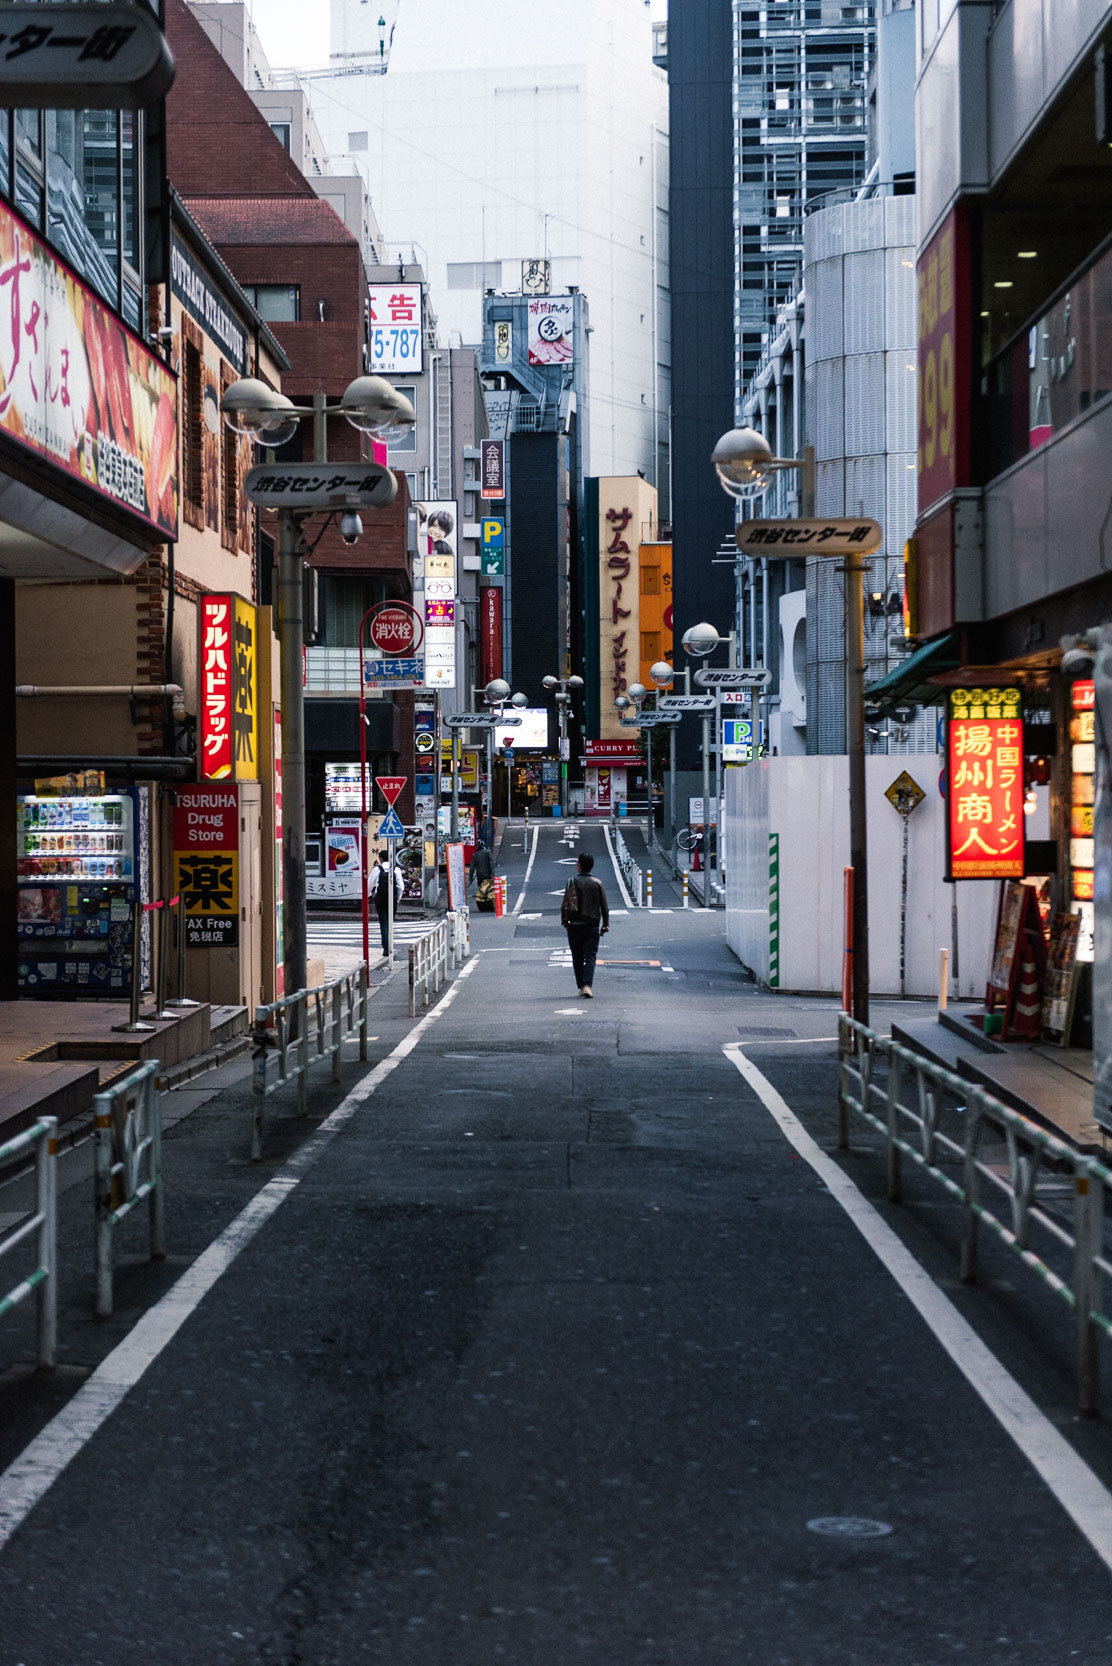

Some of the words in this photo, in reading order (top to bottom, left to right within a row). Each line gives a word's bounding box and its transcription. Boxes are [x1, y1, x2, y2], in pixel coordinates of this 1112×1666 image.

[172, 245, 205, 315] OUTBACK
[486, 445, 500, 486] 会議室
[252, 475, 383, 493] 渋谷センター街
[484, 521, 502, 543] P
[745, 526, 872, 543] 渋谷センター街
[606, 507, 632, 624] サムラート
[487, 598, 497, 635] kawara
[375, 622, 411, 639] 消火栓
[380, 659, 424, 675] セキネ
[204, 604, 229, 756] ツルハドラッグ
[703, 673, 767, 682] 渋谷センター街
[664, 698, 713, 707] 渋谷センター街
[726, 693, 743, 702] 入口
[734, 723, 750, 743] P
[383, 782, 401, 790] 止まれ
[953, 724, 998, 855] 揚州商人
[996, 724, 1019, 855] 中国ラーメン
[176, 794, 237, 808] TSURUHA
[188, 812, 224, 827] Drug
[188, 829, 224, 841] Store
[178, 855, 233, 909] 薬
[207, 918, 232, 929] Free
[190, 931, 223, 942] 免税店
